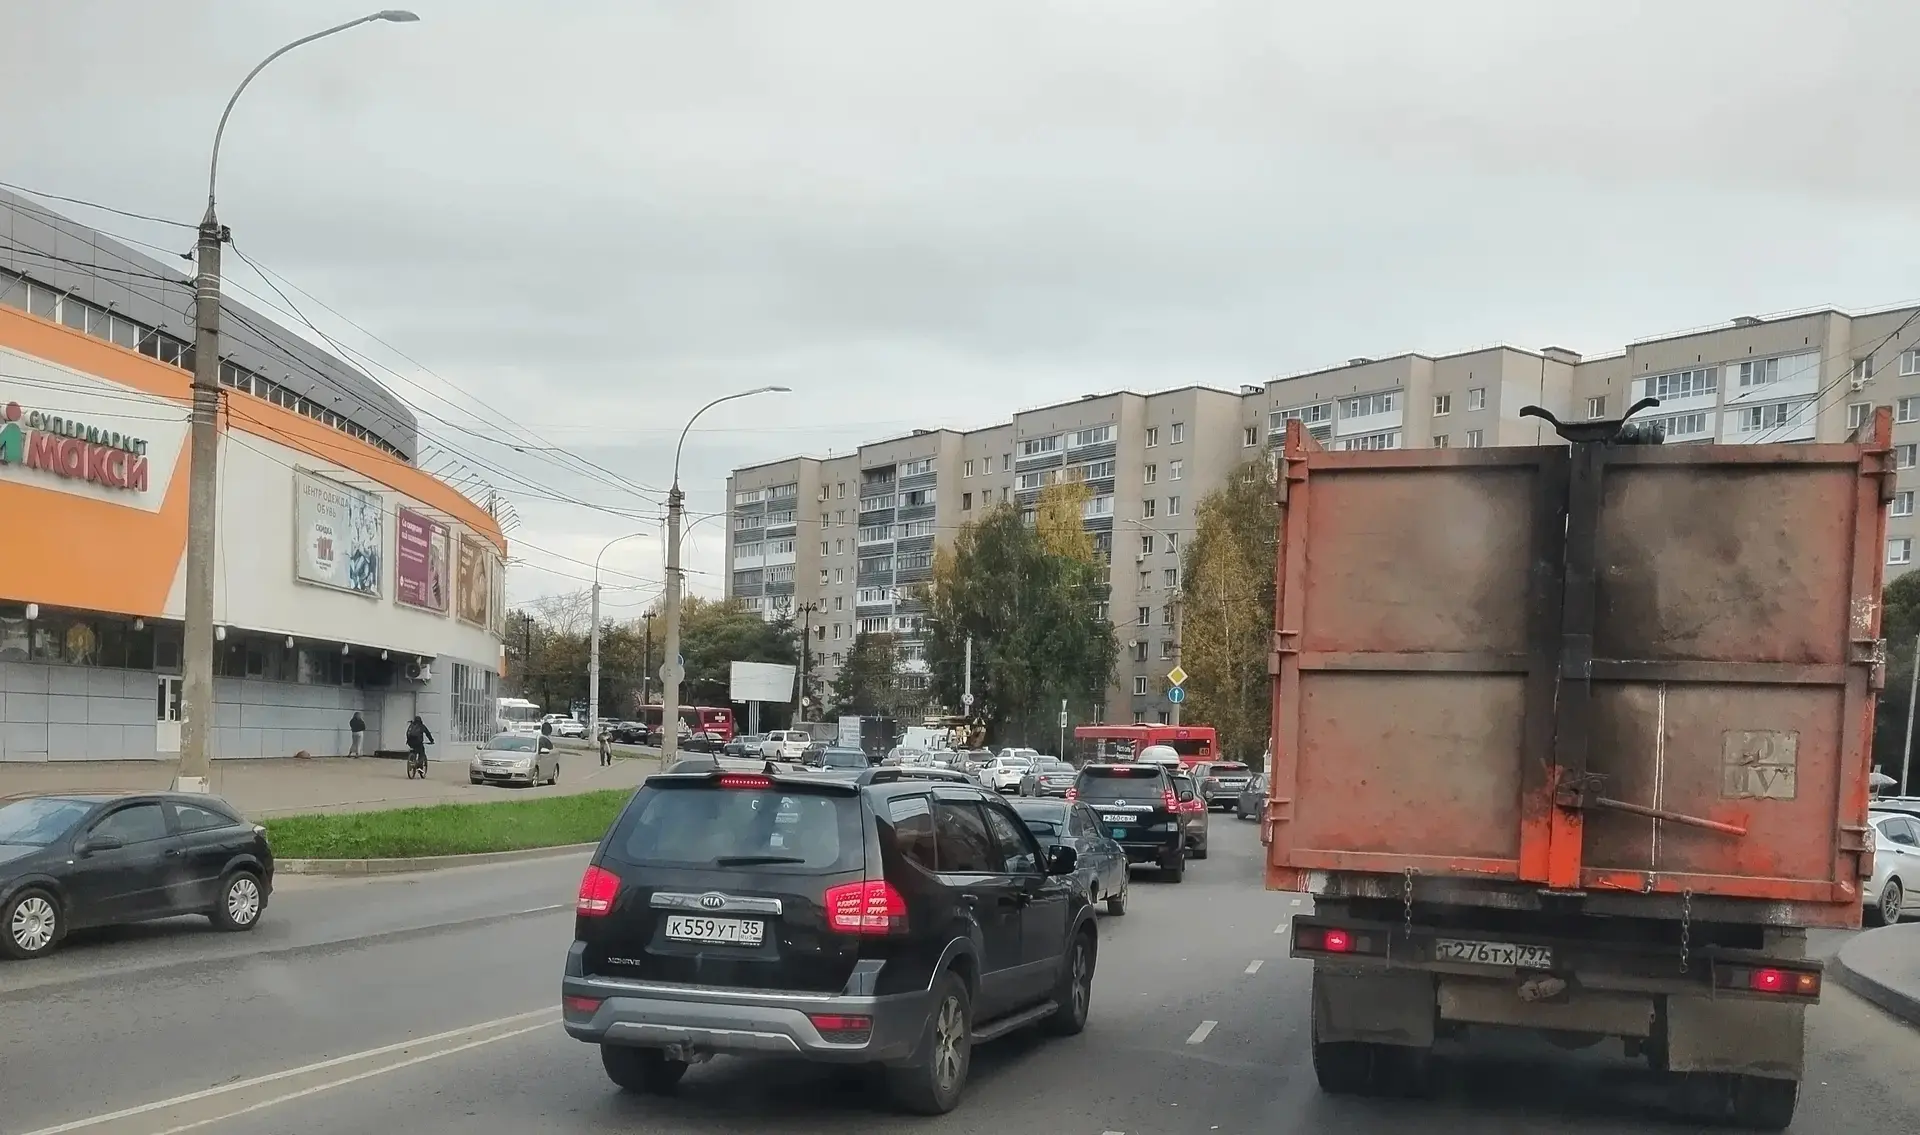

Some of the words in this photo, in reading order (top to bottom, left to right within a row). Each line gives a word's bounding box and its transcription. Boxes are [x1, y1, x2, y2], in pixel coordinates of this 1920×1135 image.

[29, 410, 149, 456] СУПЕРМАРКЕТ
[303, 484, 322, 499] ЦЕНТР
[323, 491, 349, 508] ОДЕЖДА
[317, 503, 336, 518] ОБУВЬ
[316, 523, 332, 535] СКИДКА
[703, 896, 722, 907] KIA
[672, 919, 737, 938] К559УТ
[742, 921, 759, 934] 35
[1442, 942, 1513, 963] Т276ТХ
